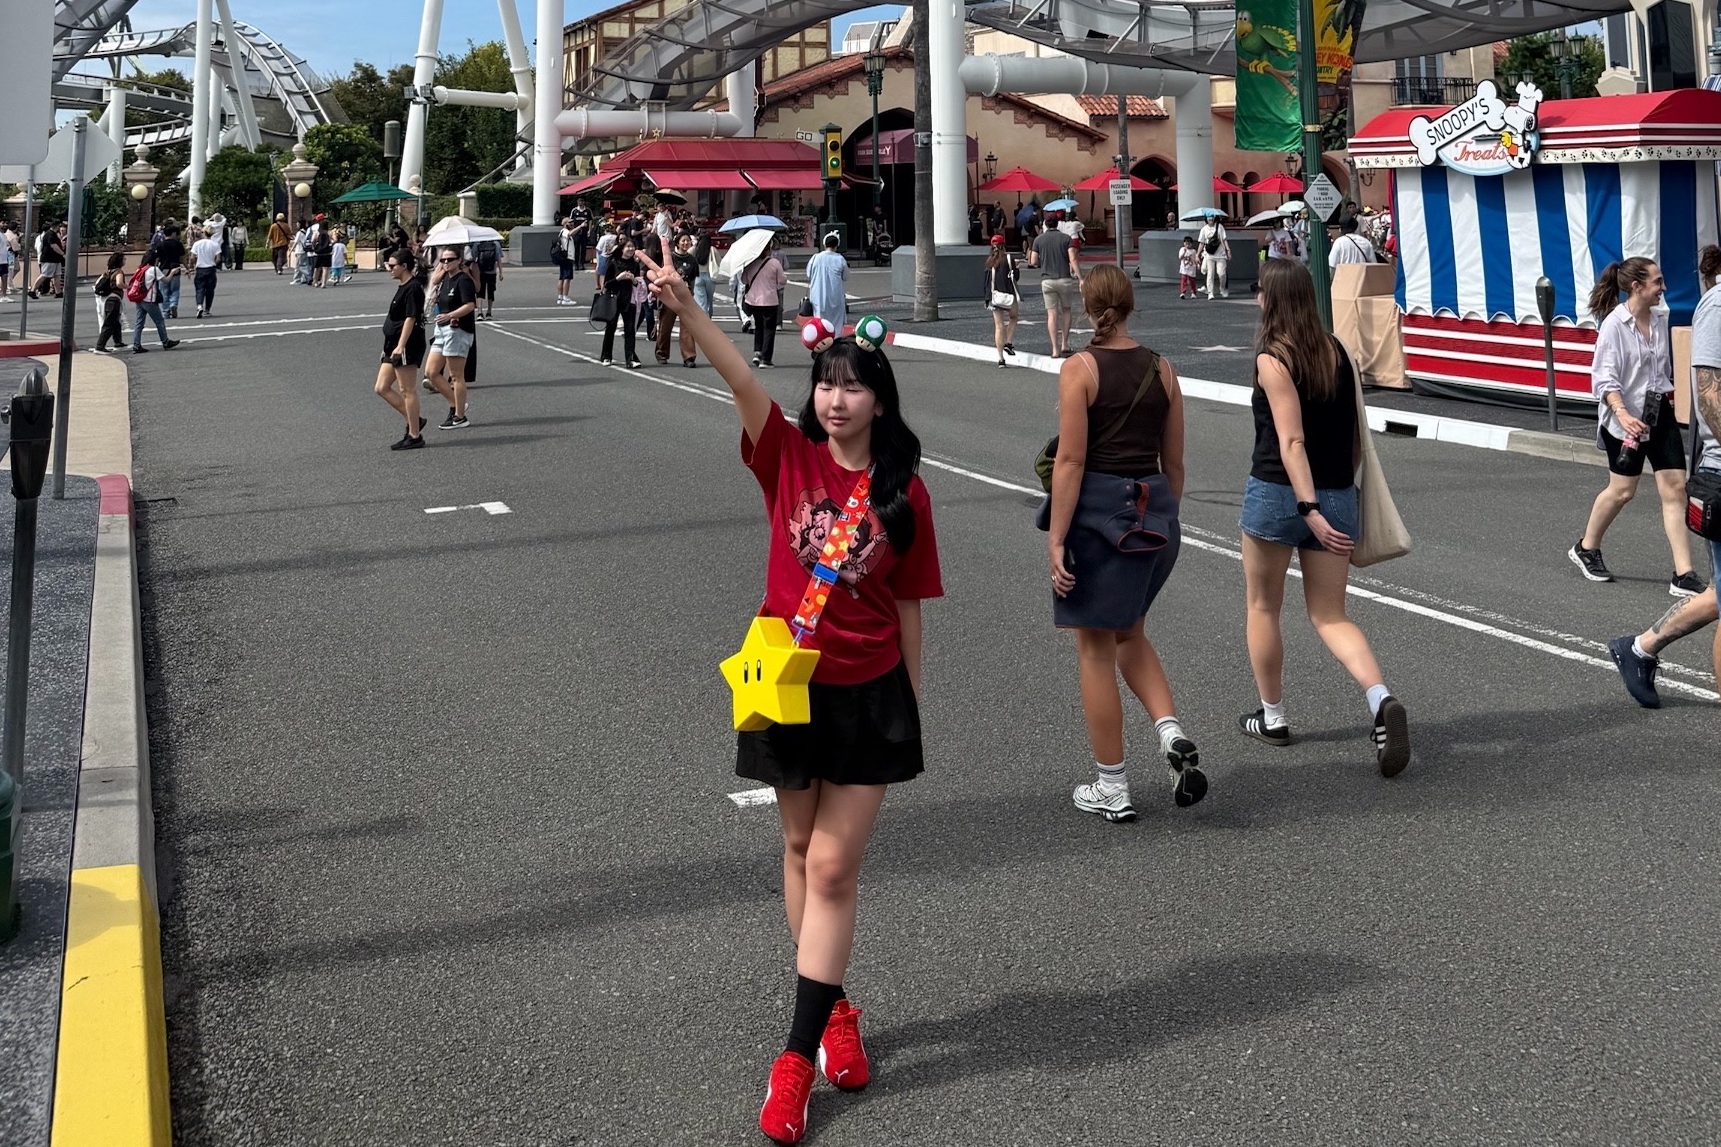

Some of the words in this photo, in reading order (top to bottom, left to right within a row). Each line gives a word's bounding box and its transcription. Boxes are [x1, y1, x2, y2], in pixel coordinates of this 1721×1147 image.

[1426, 98, 1490, 145] SNOOPY'S
[796, 131, 813, 141] GO
[1454, 141, 1507, 161] Treats
